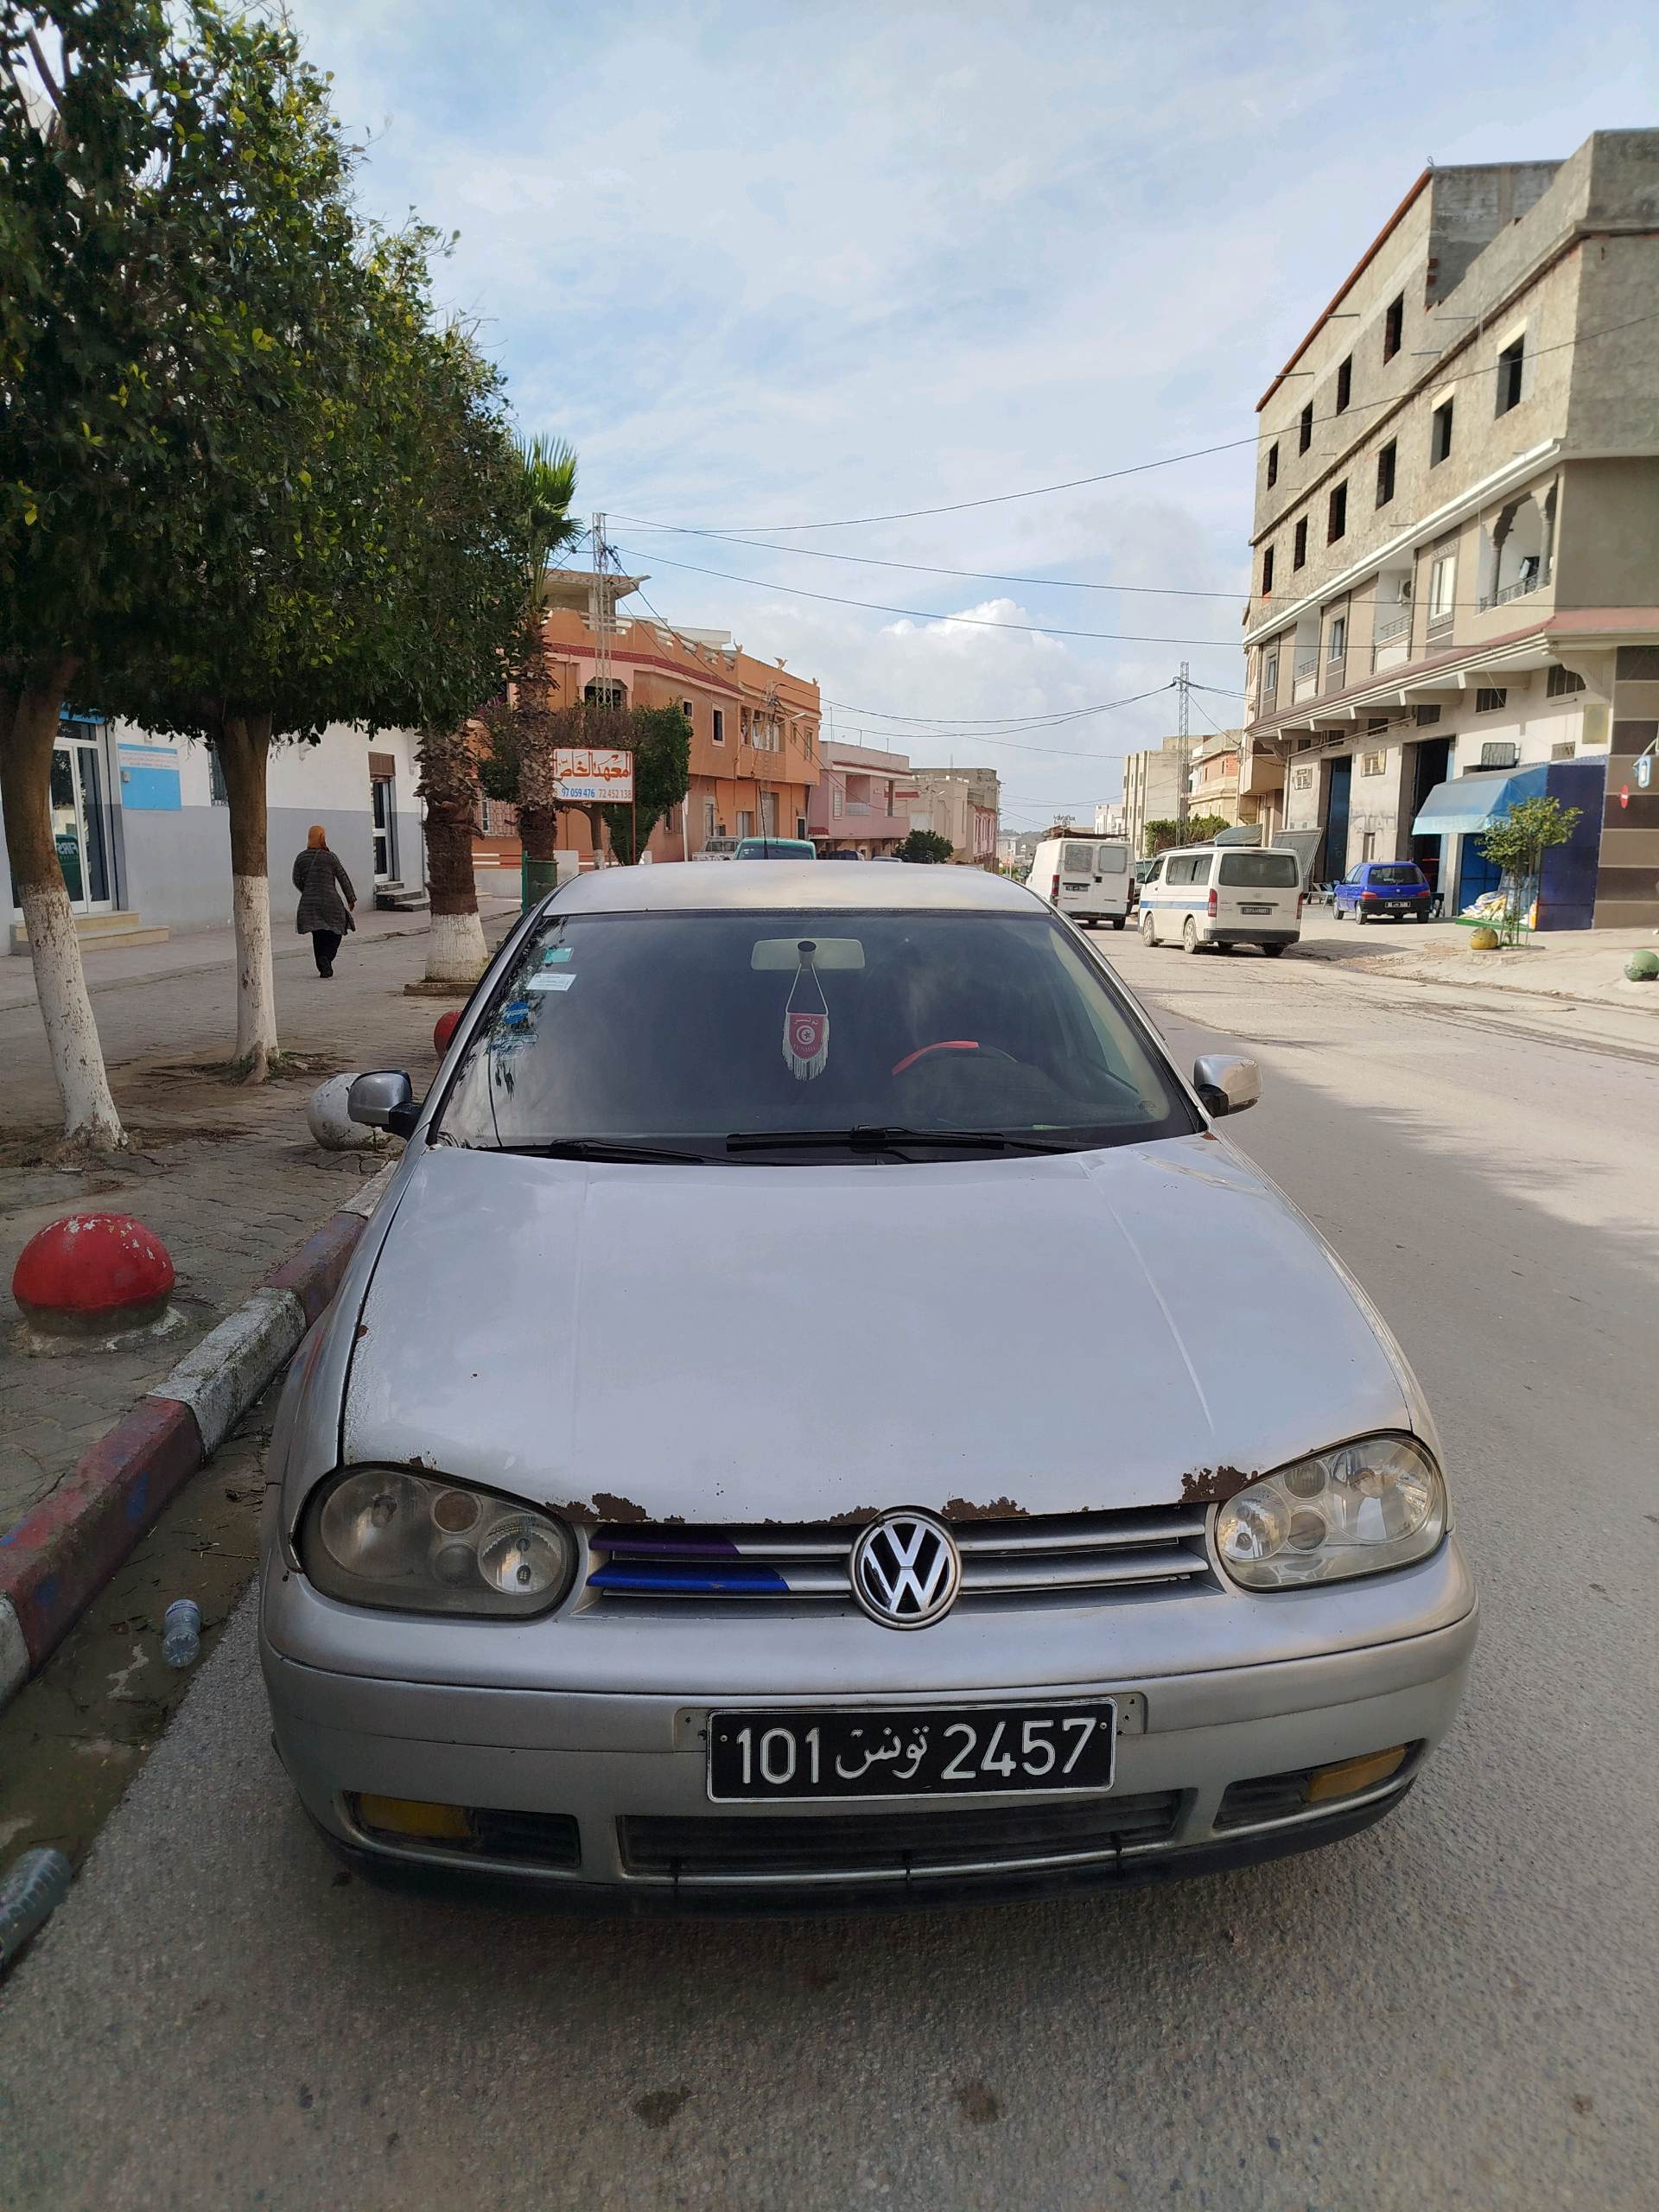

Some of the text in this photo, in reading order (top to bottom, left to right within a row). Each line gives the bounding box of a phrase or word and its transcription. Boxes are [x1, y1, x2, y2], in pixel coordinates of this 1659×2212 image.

[582, 788, 595, 798] 476
[736, 1717, 1097, 1785] 101 تونس 2457
